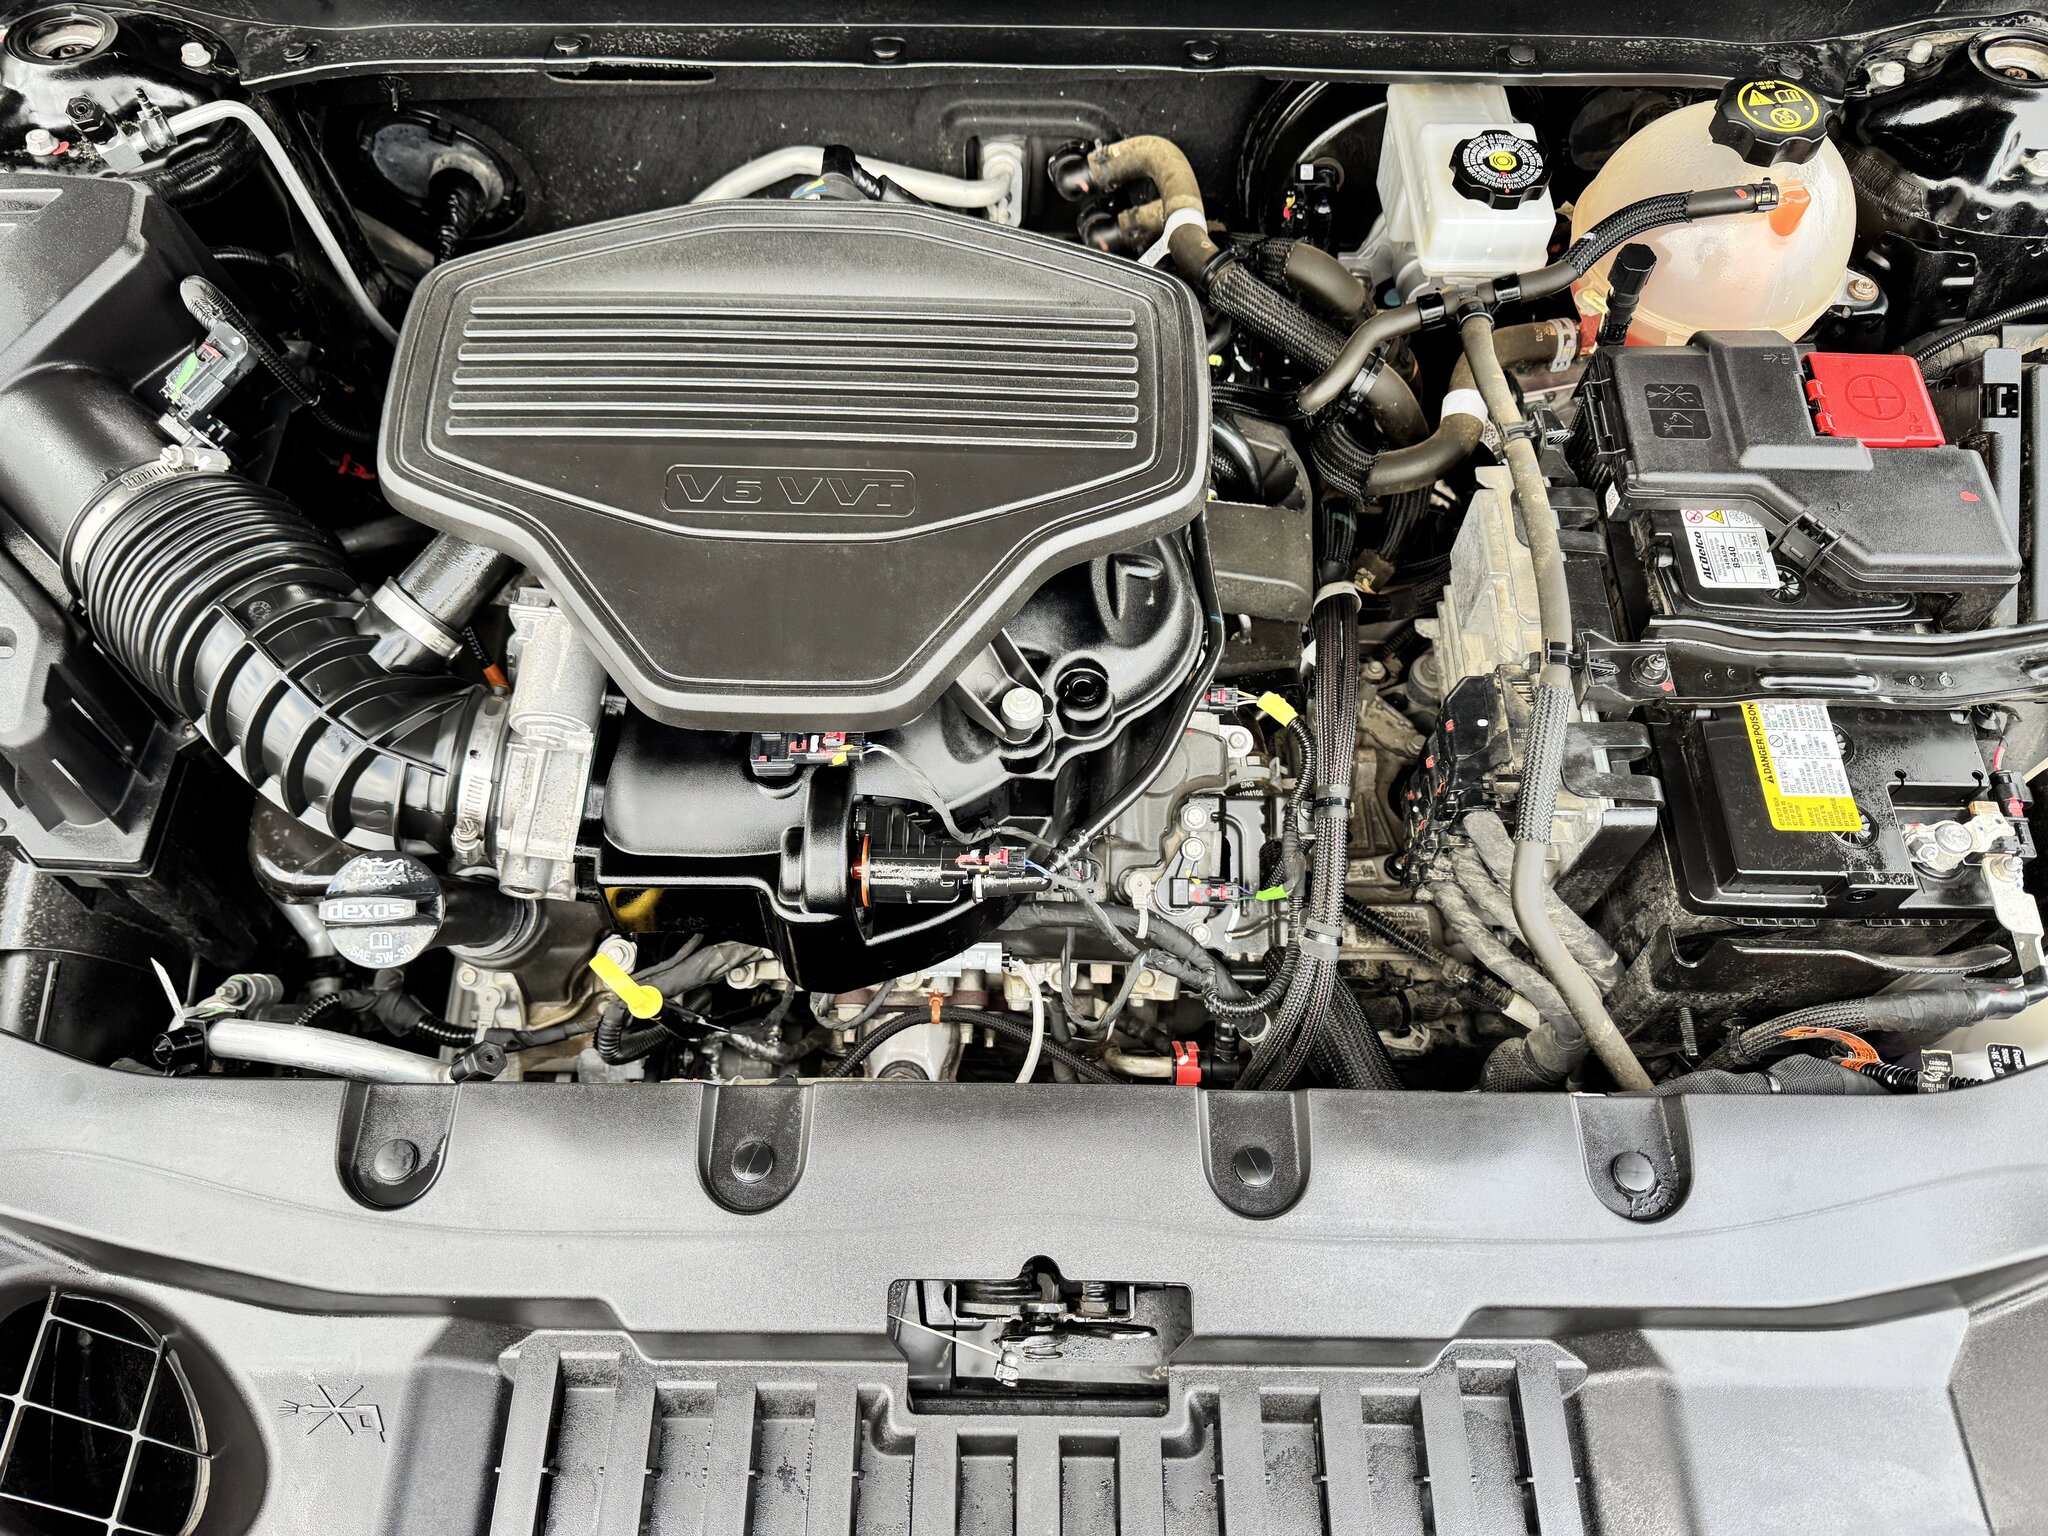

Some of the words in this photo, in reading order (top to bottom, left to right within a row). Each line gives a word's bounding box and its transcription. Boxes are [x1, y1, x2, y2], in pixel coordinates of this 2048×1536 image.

[676, 474, 763, 504] V6
[777, 476, 905, 506] VVT
[1694, 531, 1713, 581] ACDelco
[1728, 546, 1741, 568] 8540
[327, 900, 405, 919] dexos
[350, 944, 371, 960] SAE
[375, 943, 414, 964] 5W-30
